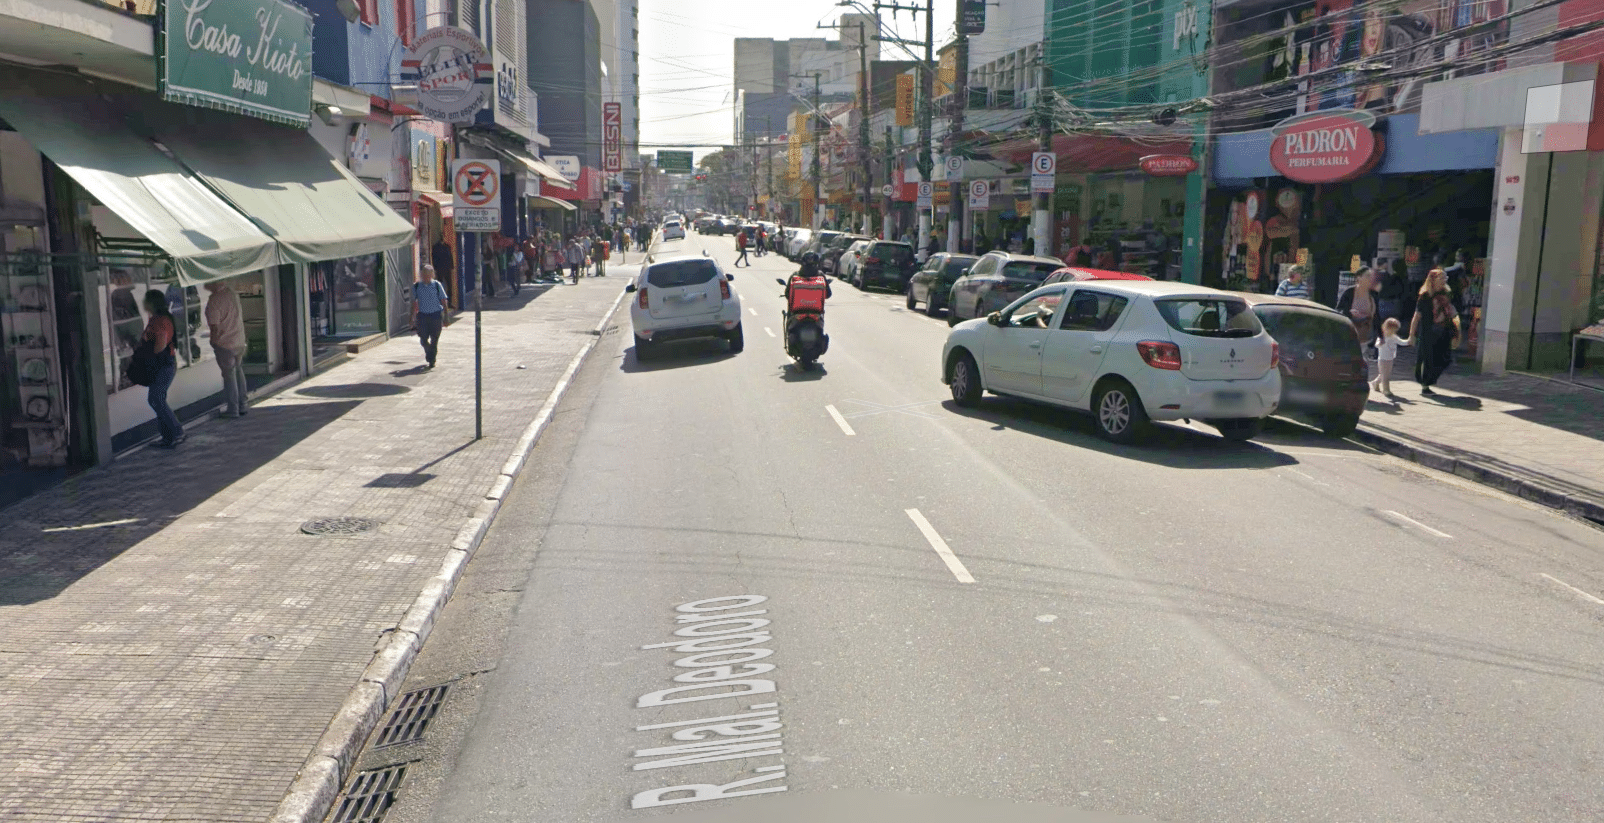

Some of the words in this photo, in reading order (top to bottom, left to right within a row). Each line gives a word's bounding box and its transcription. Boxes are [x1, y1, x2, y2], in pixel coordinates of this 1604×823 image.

[182, 0, 243, 58] Casa
[247, 7, 304, 80] Kioto
[409, 29, 443, 53] Materiais
[446, 27, 486, 58] Esportivos
[416, 50, 480, 78] ELITE
[232, 69, 252, 91] Desde
[420, 68, 480, 93] SPORT
[424, 107, 446, 119] opção
[448, 111, 460, 119] em
[460, 91, 486, 117] esporte!
[606, 104, 620, 170] BESNI
[1285, 126, 1359, 155] PADRON
[1040, 158, 1048, 169] E
[1288, 156, 1351, 168] PERFUMARIA
[976, 185, 983, 193] E
